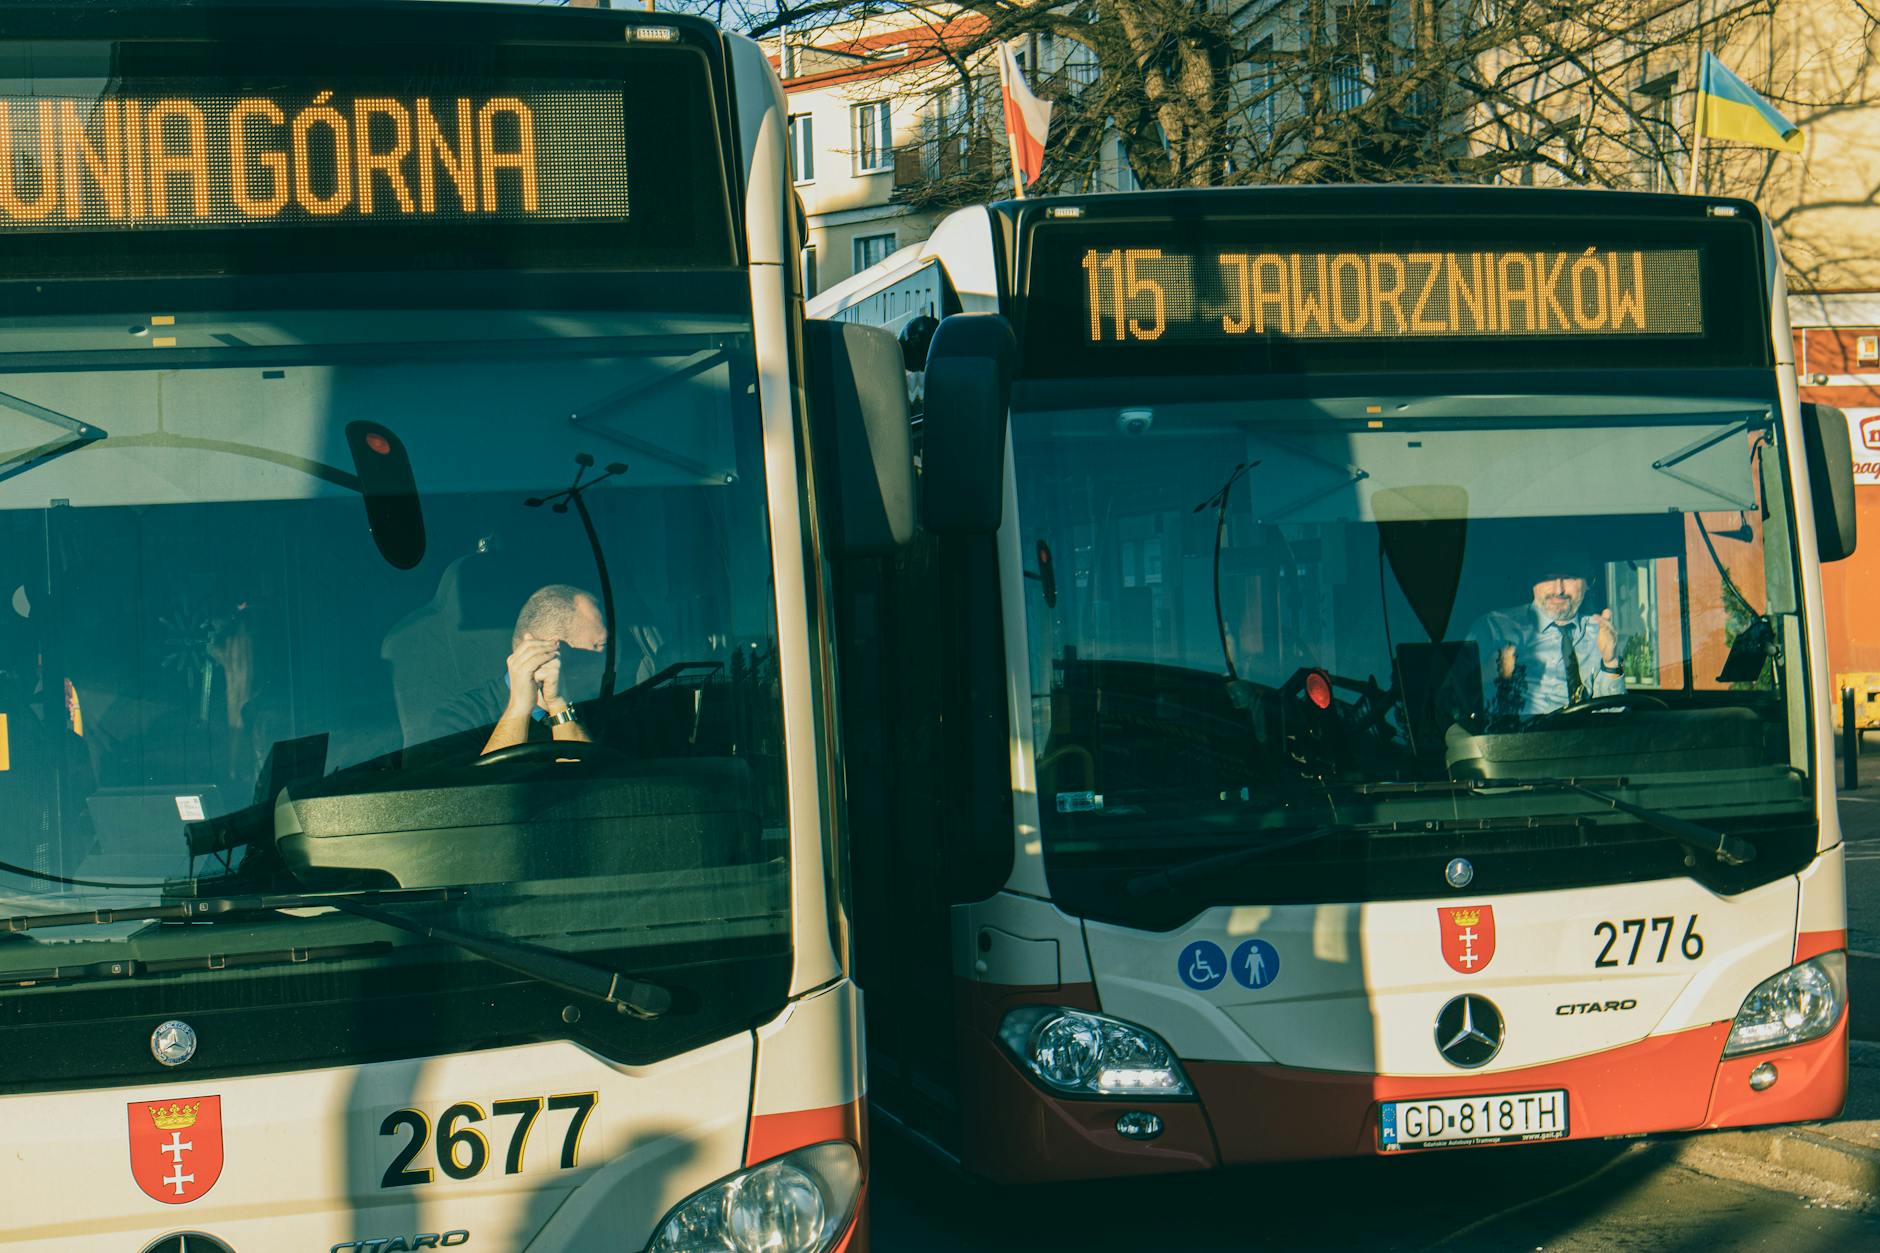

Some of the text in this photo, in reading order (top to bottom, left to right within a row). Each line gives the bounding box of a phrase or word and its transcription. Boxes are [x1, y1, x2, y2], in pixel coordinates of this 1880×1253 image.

[229, 91, 538, 217] GÓRNA
[1082, 246, 1646, 340] 115 JAWORZNIAKÓW
[1594, 914, 1704, 968] 2776
[1555, 999, 1637, 1016] CITARO
[379, 1091, 598, 1188] 2677
[1383, 1128, 1396, 1138] PL
